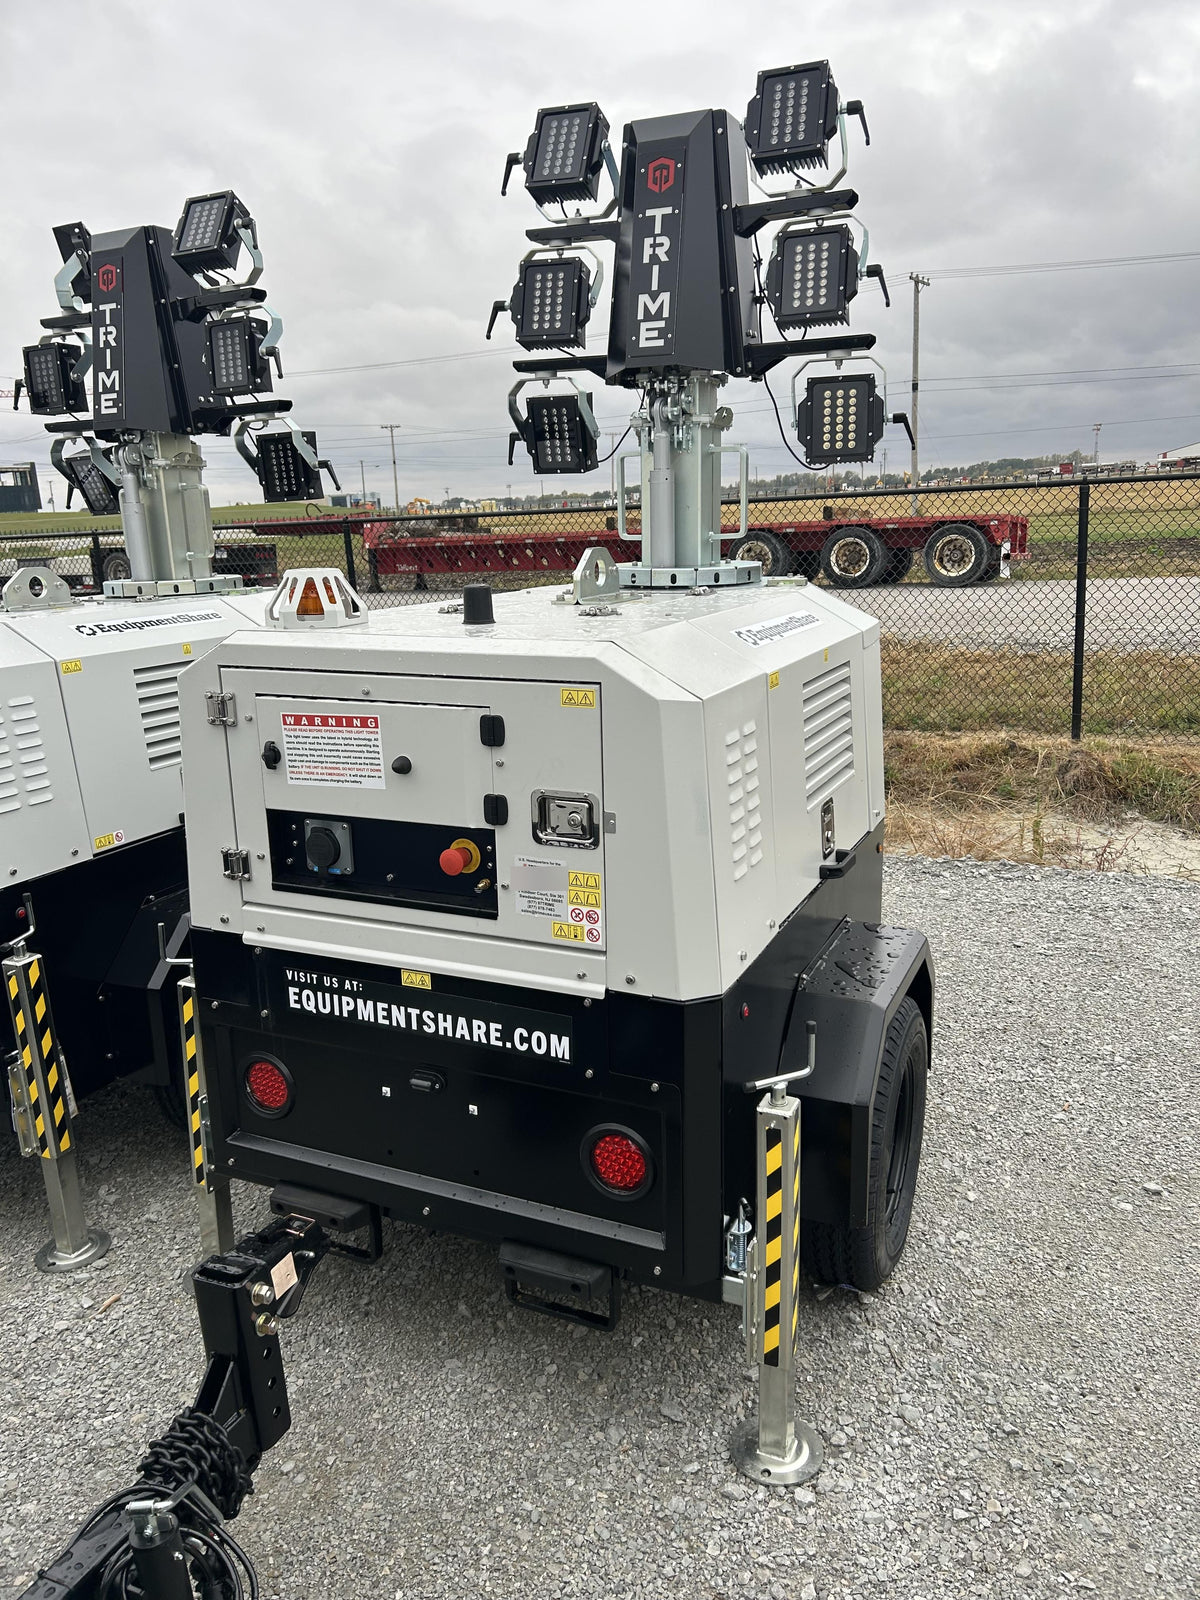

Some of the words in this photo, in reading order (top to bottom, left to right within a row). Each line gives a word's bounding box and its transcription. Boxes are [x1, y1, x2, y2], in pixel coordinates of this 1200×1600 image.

[637, 206, 672, 348] TRIME
[98, 302, 119, 414] TRIME
[93, 612, 222, 633] EquipmentShare
[746, 614, 820, 641] EquipmentShare
[284, 716, 376, 728] WARNING
[286, 969, 318, 985] VISIT
[323, 975, 339, 988] US
[343, 979, 364, 992] AT:
[287, 986, 570, 1060] EQUIPMENTSHARE.COM
